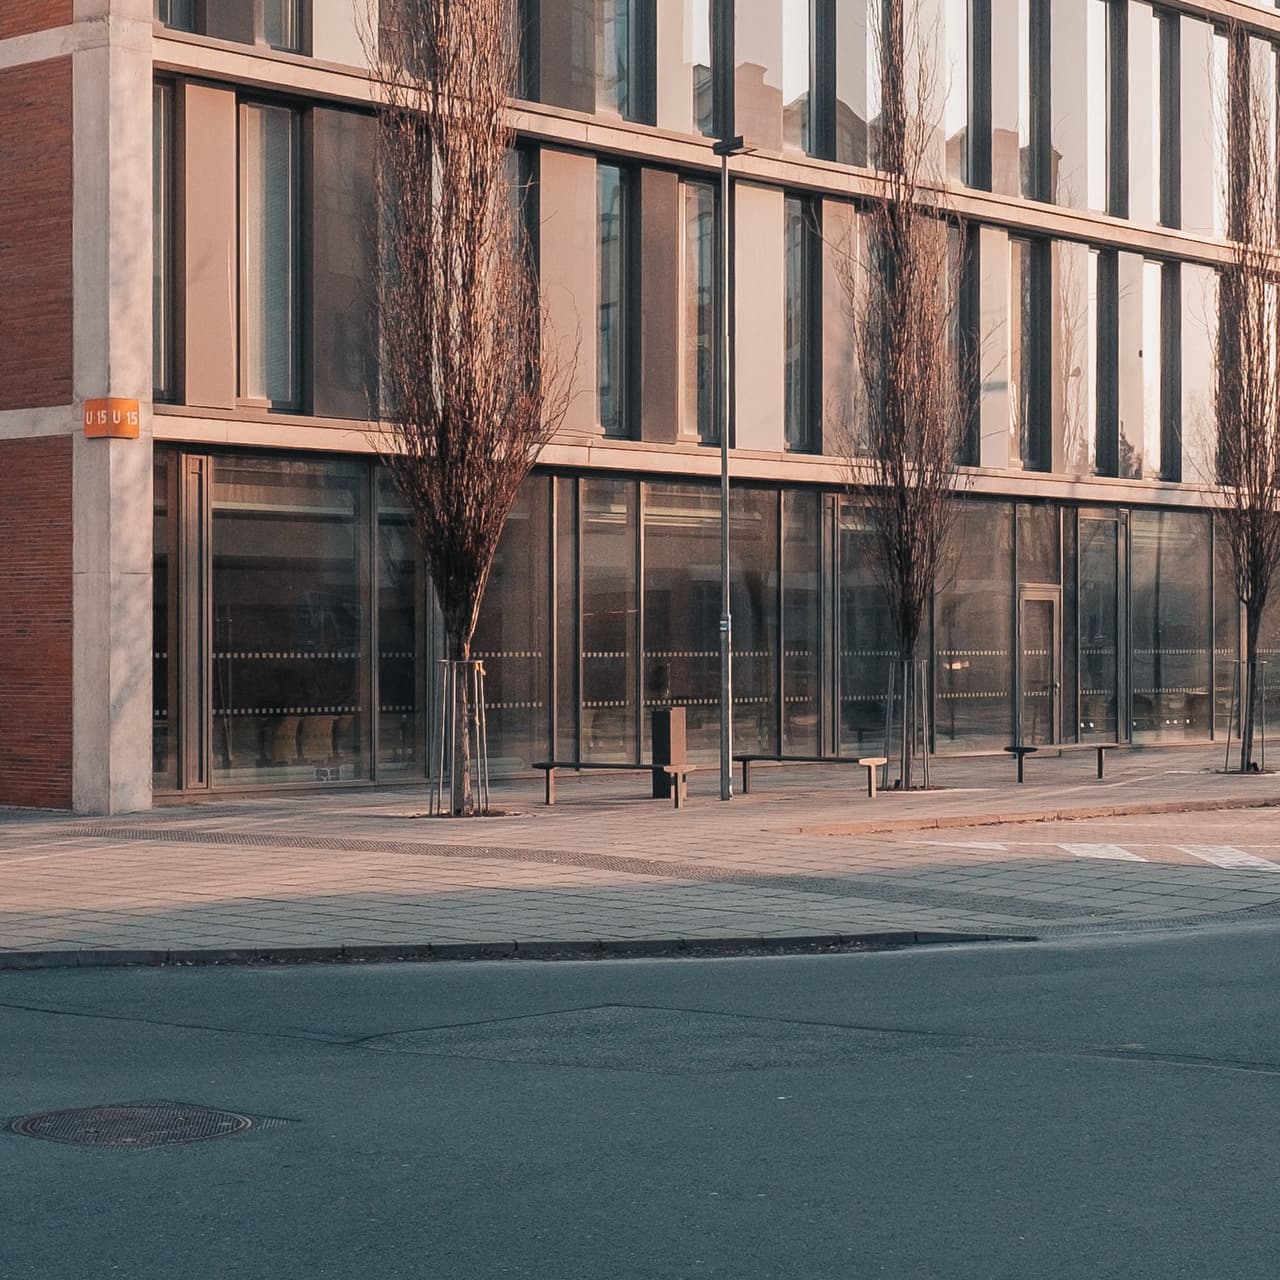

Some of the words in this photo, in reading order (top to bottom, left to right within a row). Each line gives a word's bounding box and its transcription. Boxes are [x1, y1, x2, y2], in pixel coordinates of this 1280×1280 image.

[86, 411, 93, 425] U
[96, 410, 107, 425] 15
[112, 410, 121, 424] U
[126, 411, 138, 425] 15
